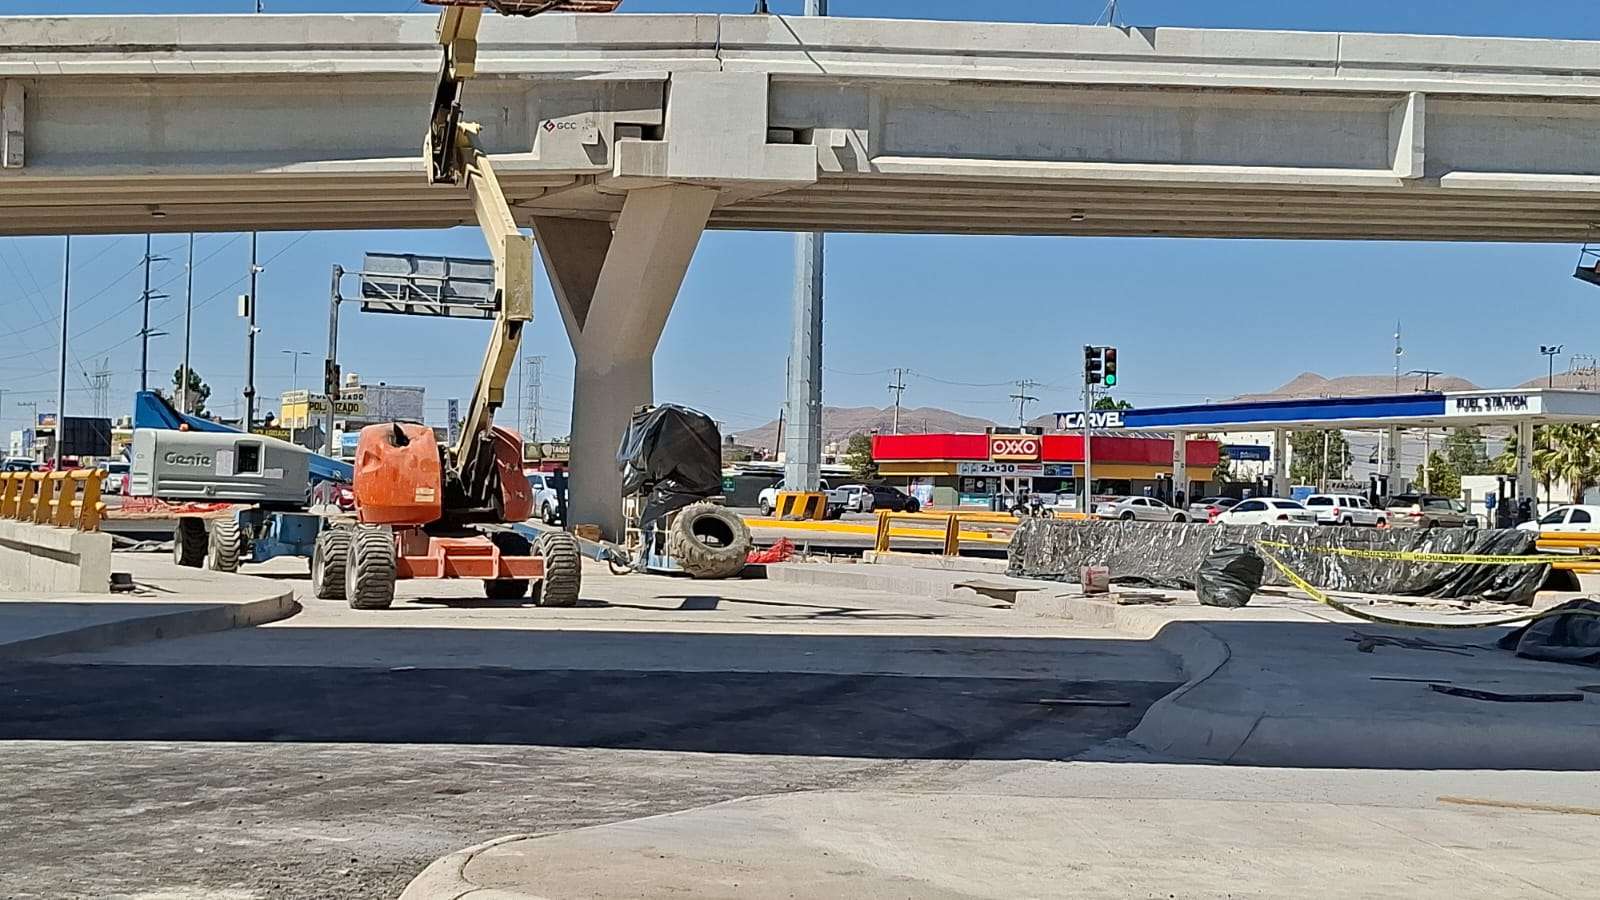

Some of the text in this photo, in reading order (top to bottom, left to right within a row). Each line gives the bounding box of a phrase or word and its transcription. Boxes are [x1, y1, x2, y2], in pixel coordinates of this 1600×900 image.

[556, 121, 577, 130] GCC
[1456, 395, 1529, 410] FUEL STATION
[1065, 411, 1124, 429] CARVEL
[992, 440, 1036, 455] OXXO
[164, 452, 211, 467] Genie
